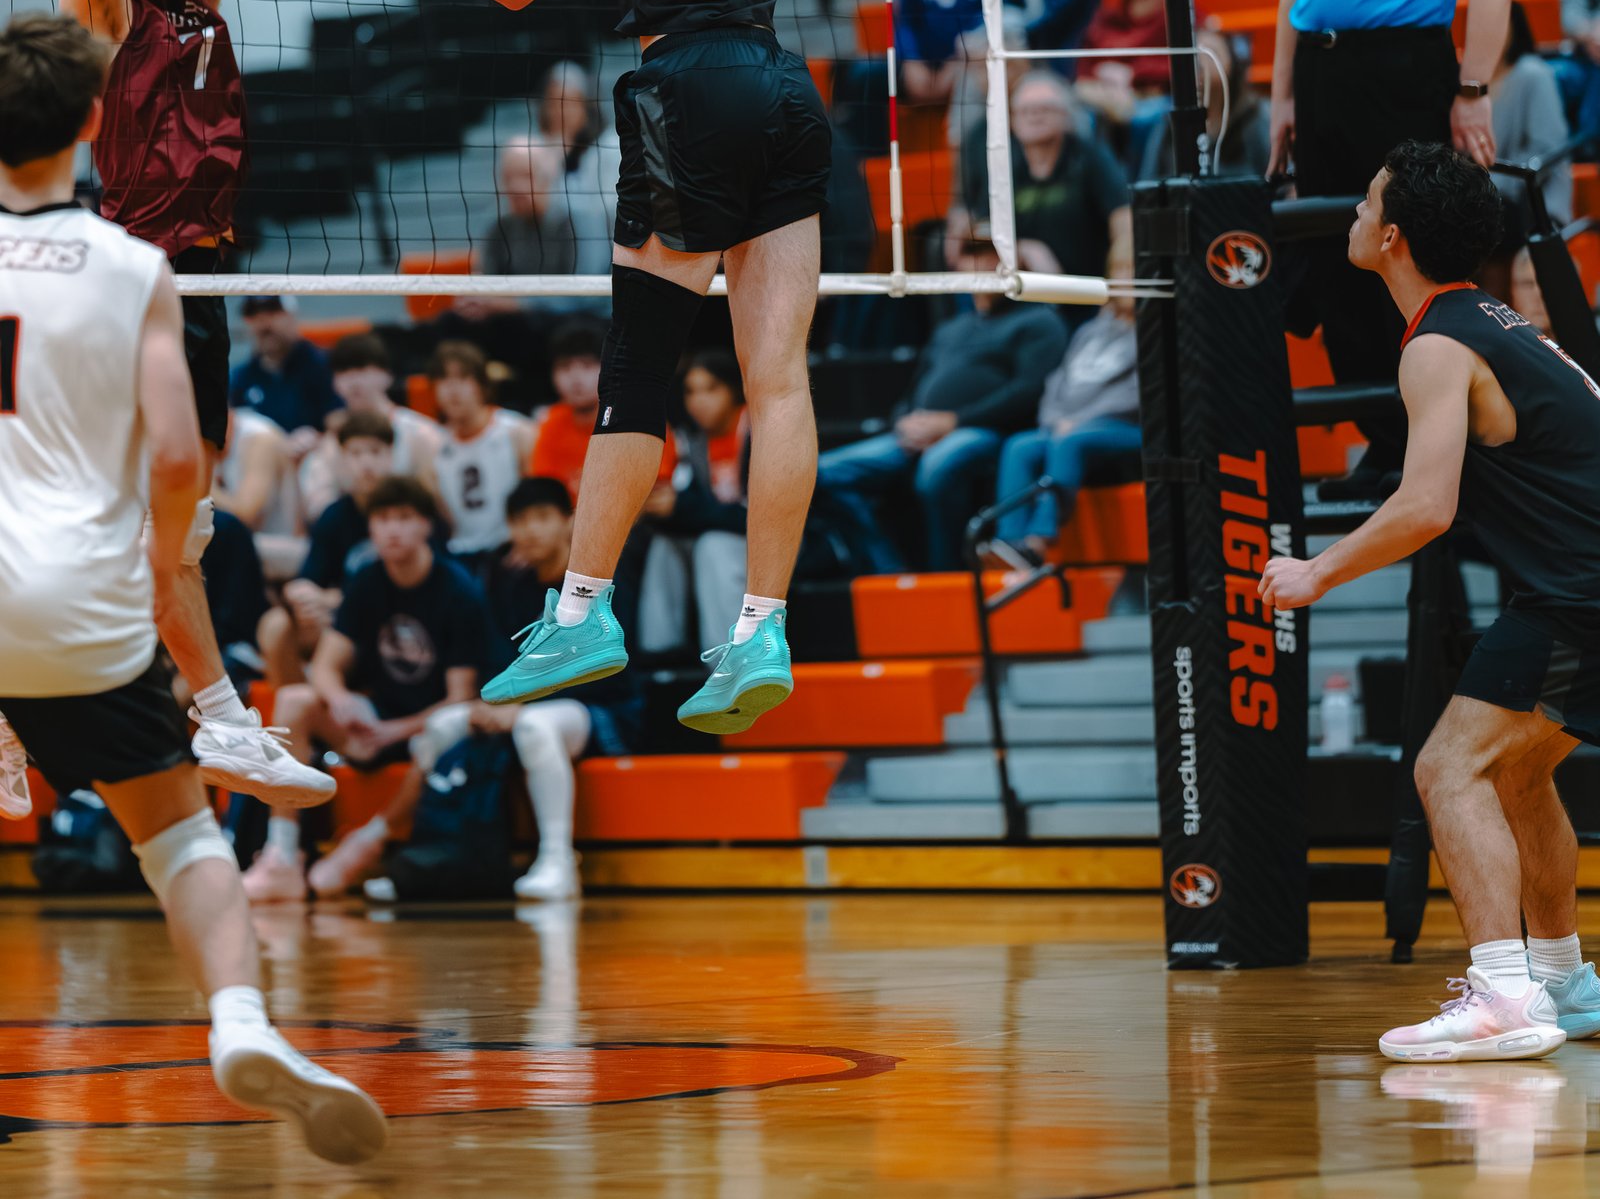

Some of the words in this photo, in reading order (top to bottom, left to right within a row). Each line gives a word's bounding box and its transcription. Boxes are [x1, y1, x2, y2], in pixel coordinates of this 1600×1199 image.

[463, 466, 484, 510] 2
[1218, 449, 1278, 732] TIGERS
[1270, 523, 1297, 654] WHS
[1173, 646, 1197, 730] sports
[1178, 732, 1202, 837] imports
